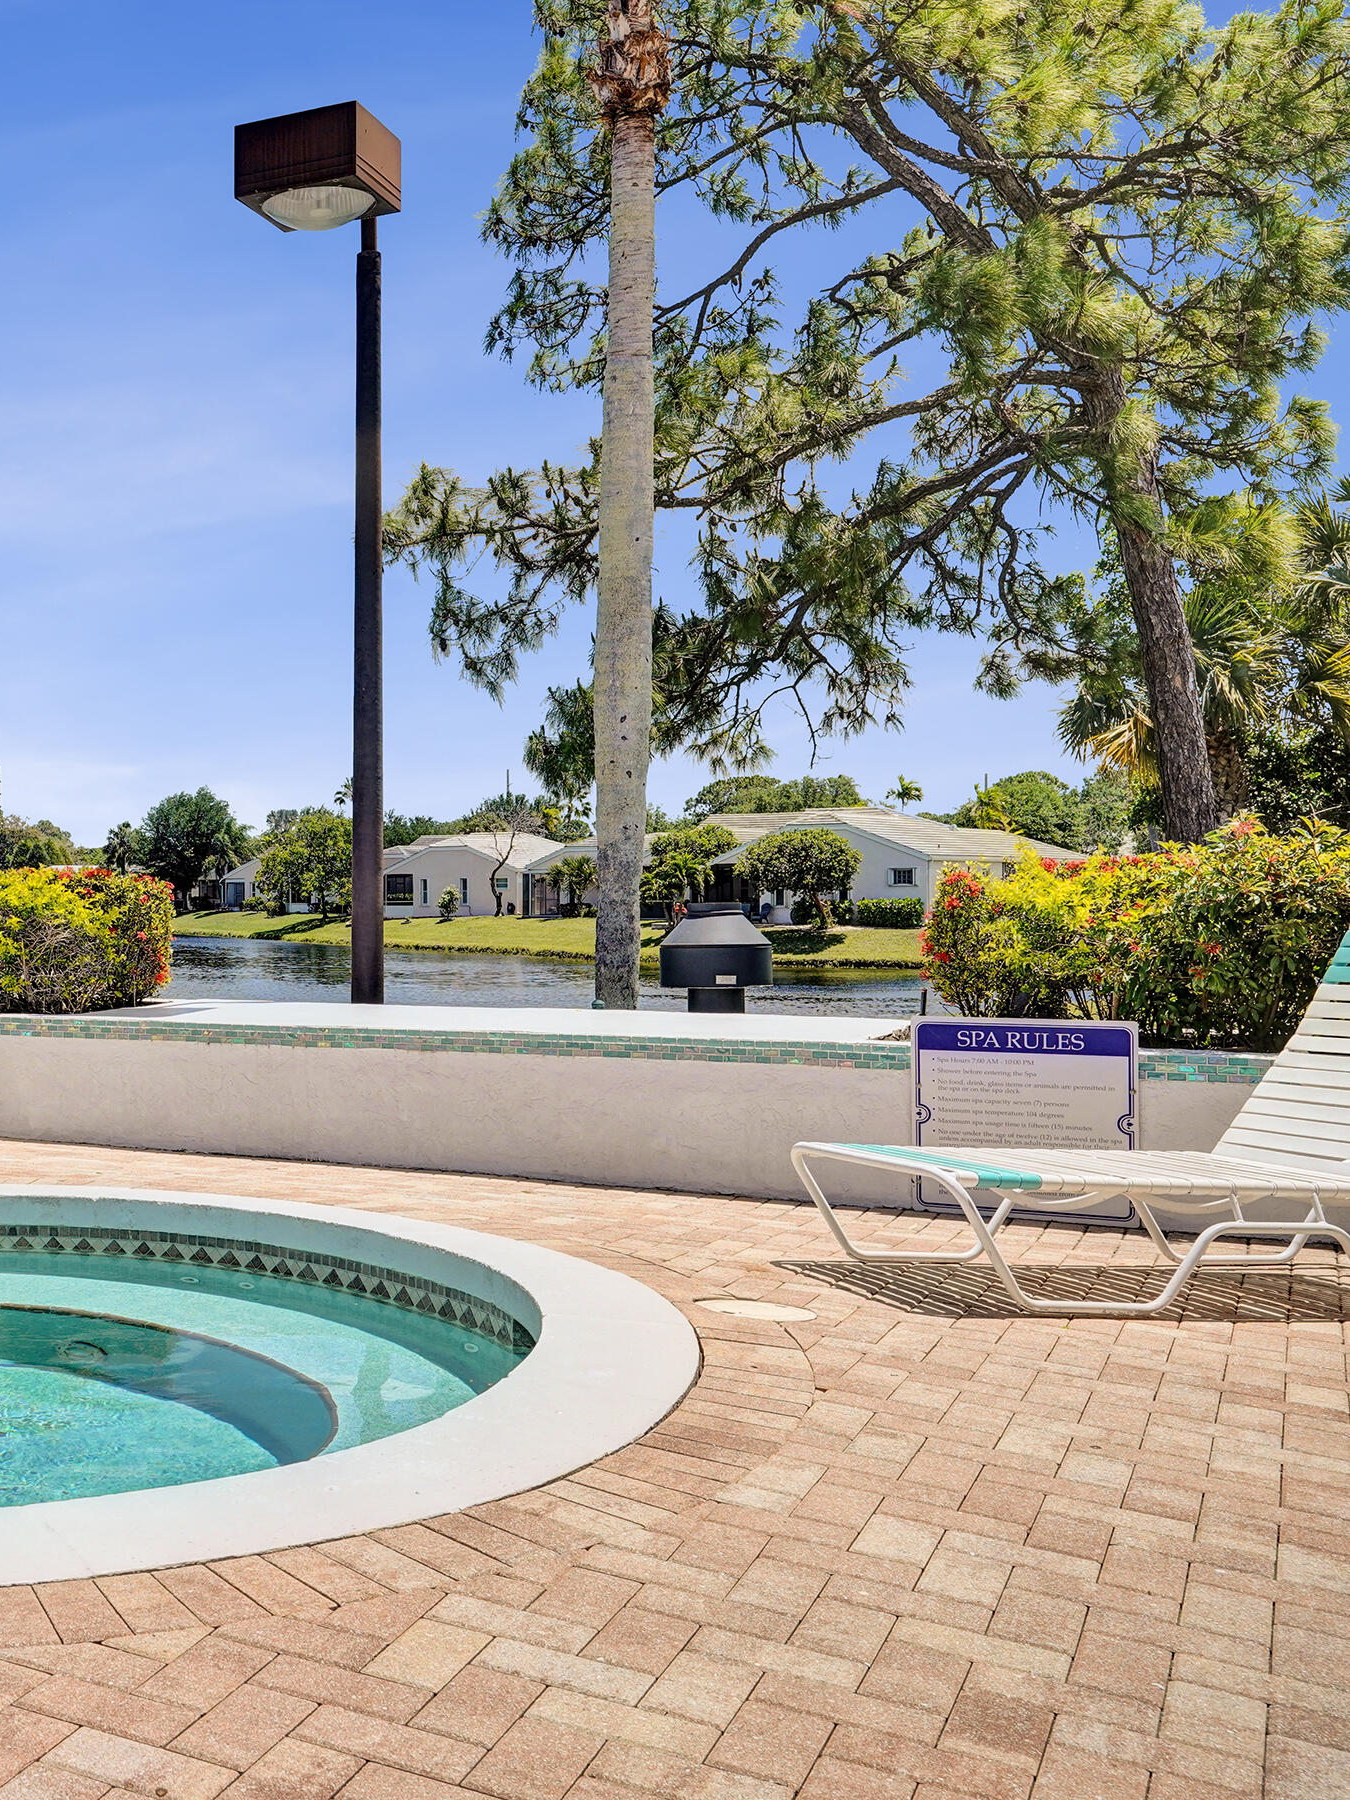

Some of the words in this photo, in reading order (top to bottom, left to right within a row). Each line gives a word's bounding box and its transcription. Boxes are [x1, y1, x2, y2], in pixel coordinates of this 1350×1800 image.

[957, 1031, 1001, 1047] SPA
[1006, 1032, 1085, 1051] RULES
[937, 1057, 949, 1065] Spa
